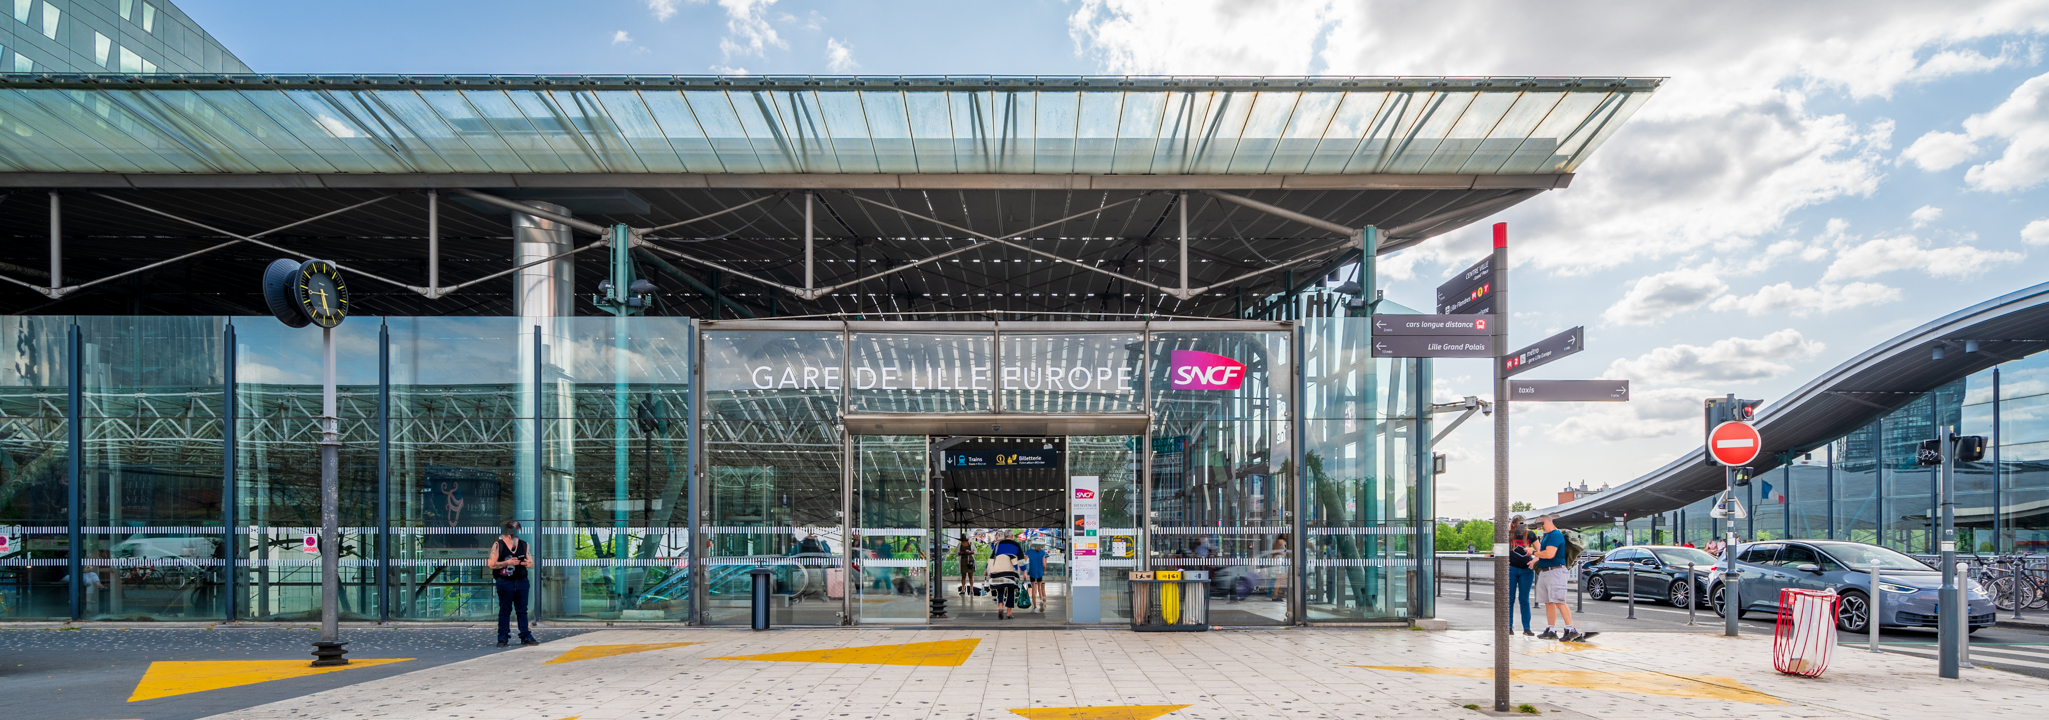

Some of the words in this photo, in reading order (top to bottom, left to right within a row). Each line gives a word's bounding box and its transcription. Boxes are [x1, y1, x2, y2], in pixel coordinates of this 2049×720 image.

[1421, 320, 1444, 329] longue
[752, 366, 842, 390] GARE
[856, 366, 904, 390] DE
[910, 366, 990, 390] LILLE
[1004, 366, 1133, 390] EUROPE
[1174, 366, 1241, 385] SNCF
